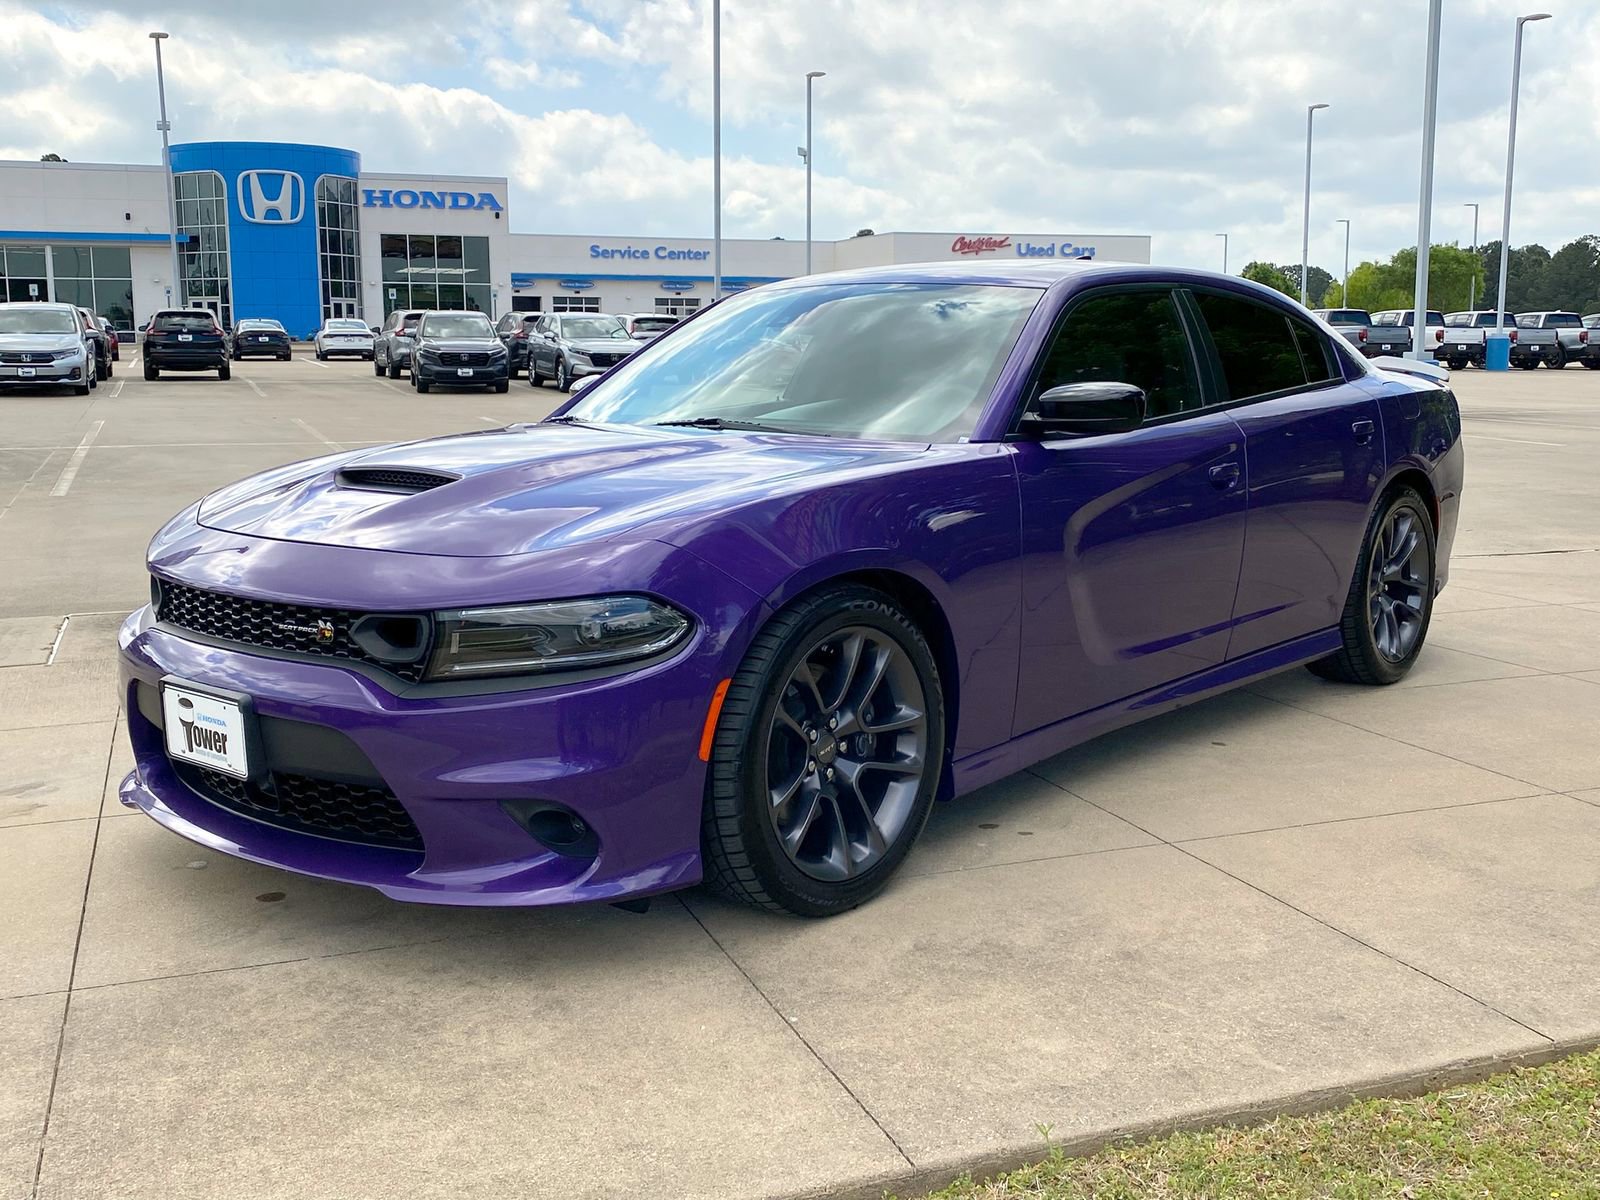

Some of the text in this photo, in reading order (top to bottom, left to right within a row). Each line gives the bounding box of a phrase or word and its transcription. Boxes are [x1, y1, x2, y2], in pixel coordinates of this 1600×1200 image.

[362, 189, 504, 211] HONDA
[590, 244, 710, 260] Service Center
[952, 236, 1096, 257] Certified Used Cars
[202, 715, 227, 727] HONDA
[179, 717, 228, 755] Tower
